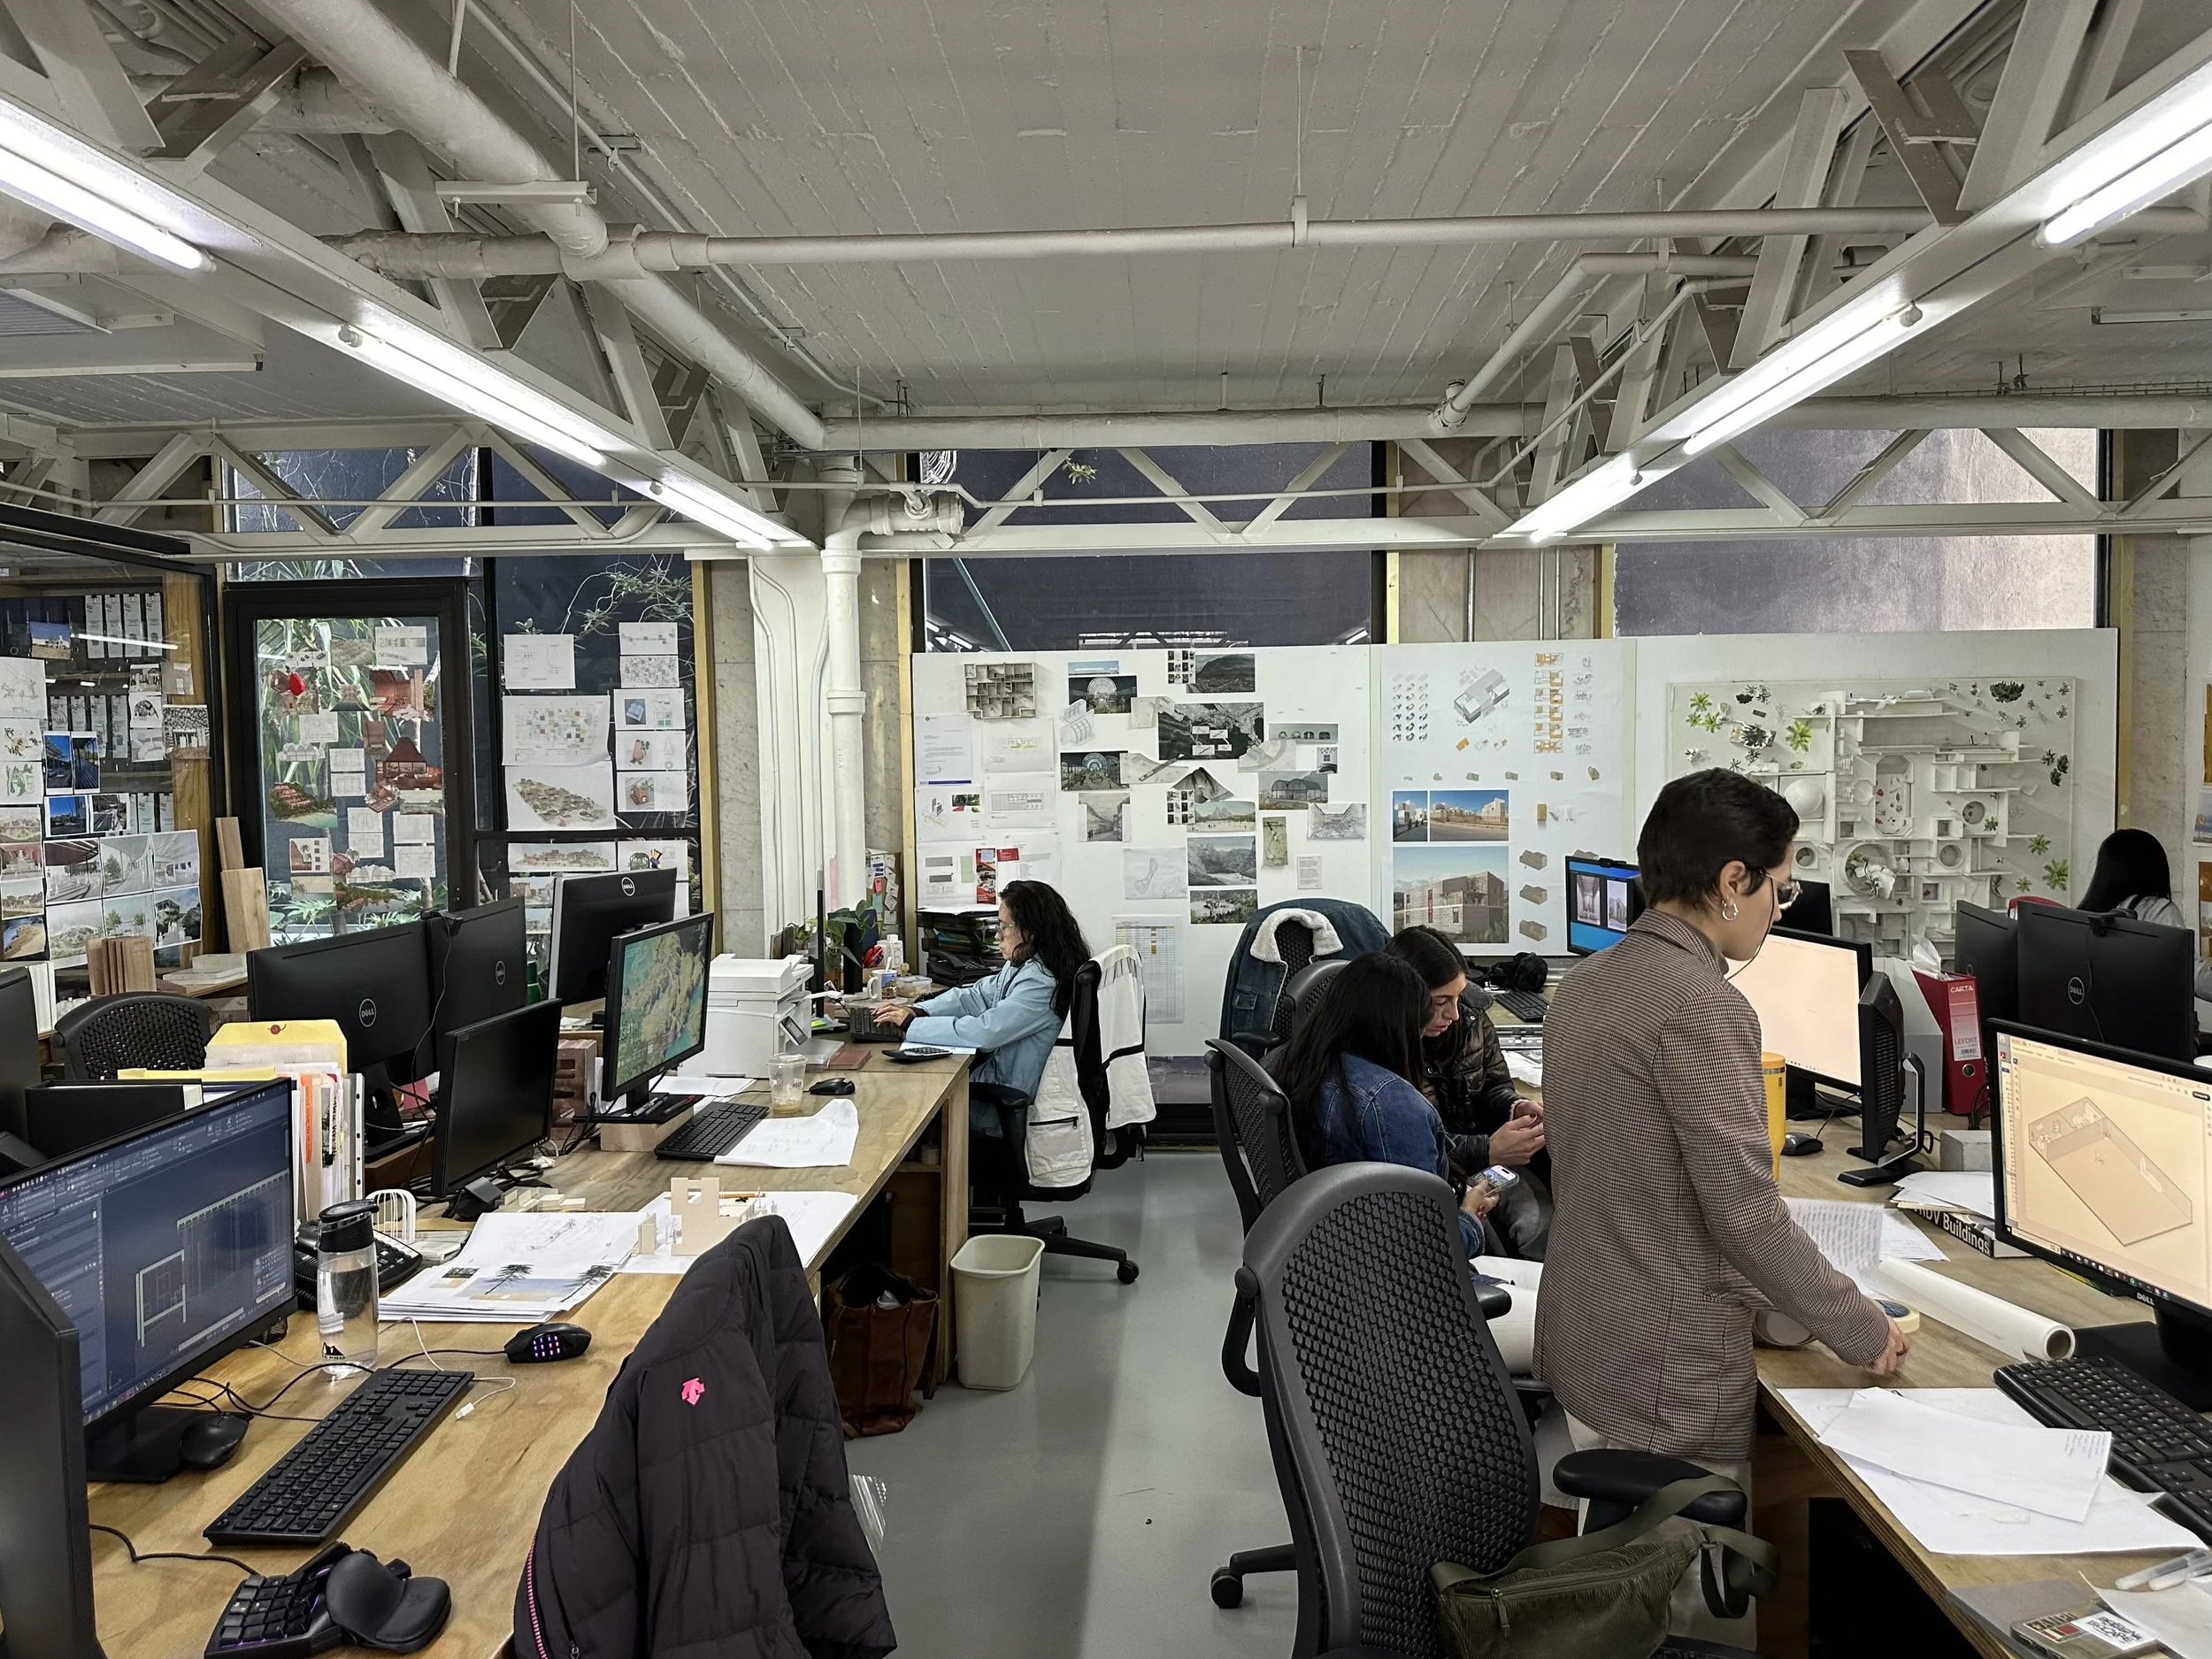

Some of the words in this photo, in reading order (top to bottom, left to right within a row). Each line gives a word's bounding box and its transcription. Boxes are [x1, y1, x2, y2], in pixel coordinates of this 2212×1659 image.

[361, 1008, 375, 1018] DELL
[1942, 1212, 1991, 1256] Buildings
[2137, 1292, 2155, 1306] DELL
